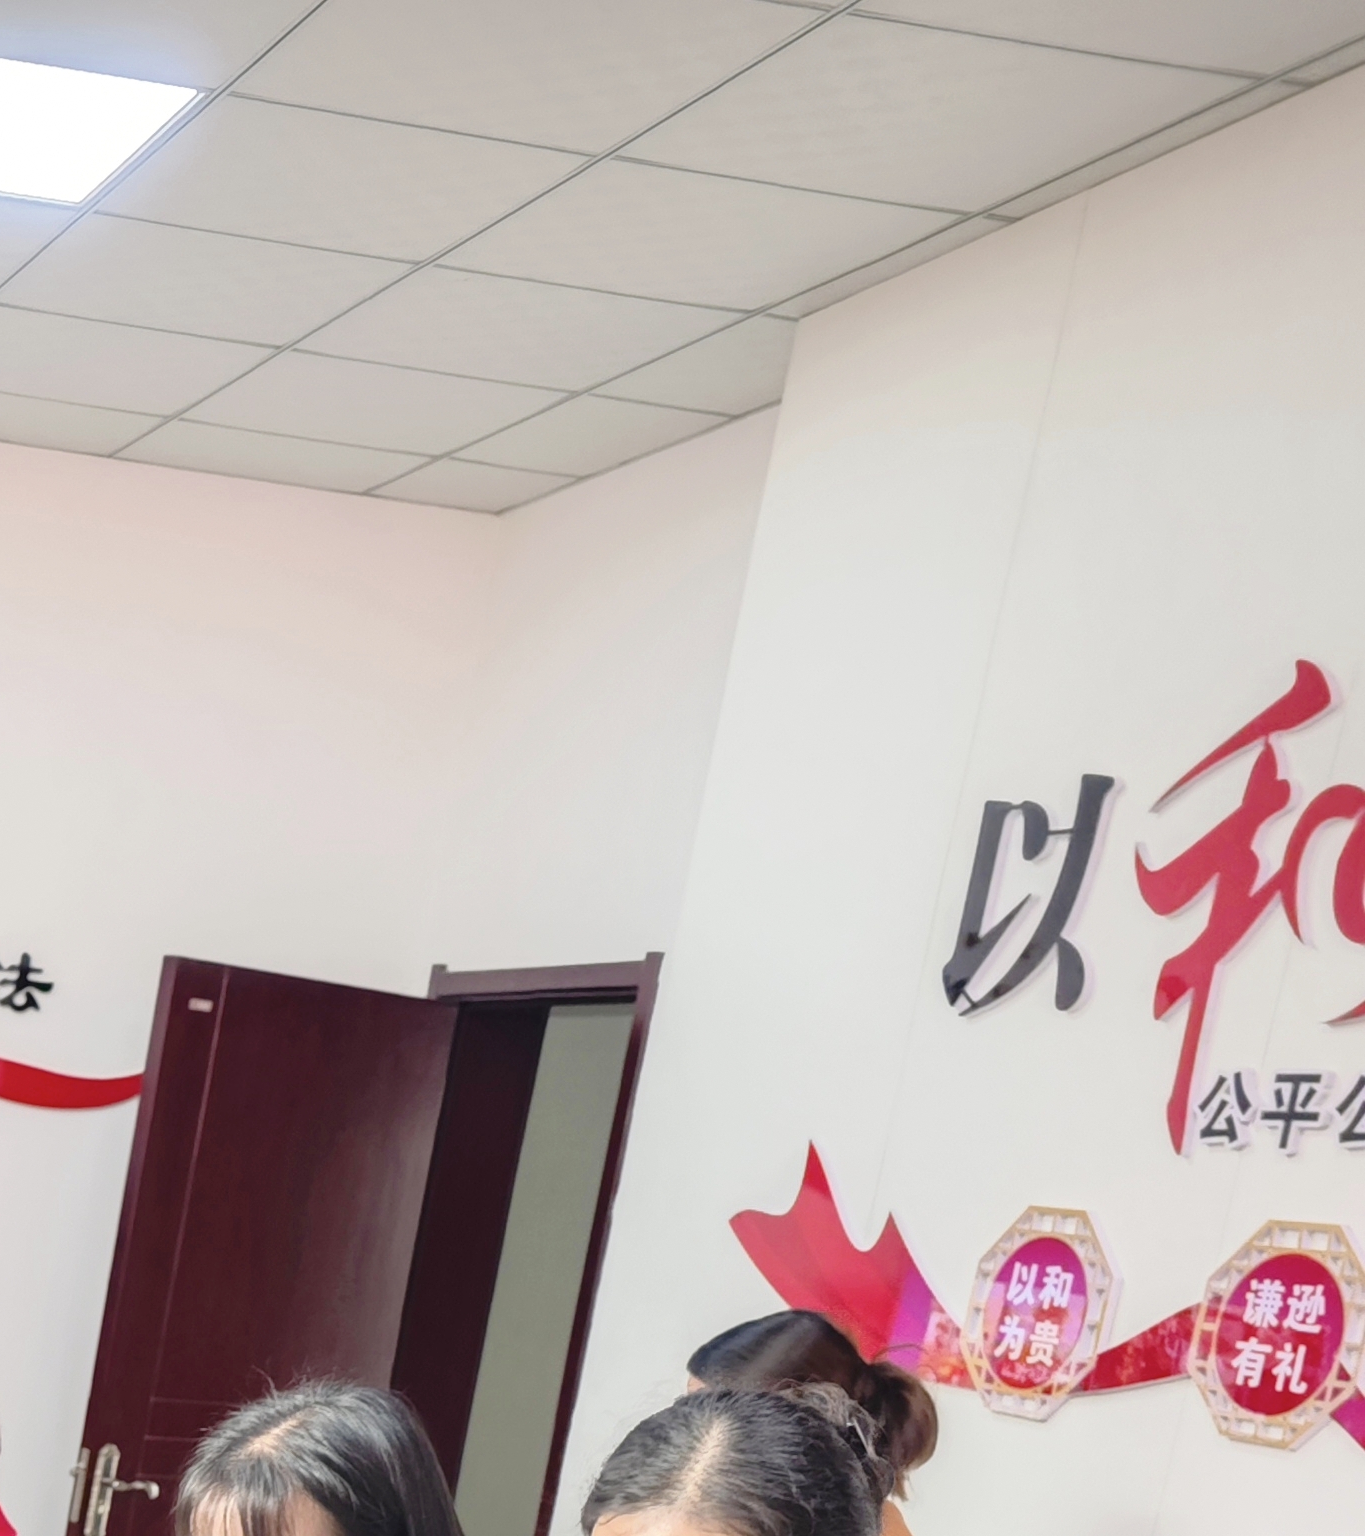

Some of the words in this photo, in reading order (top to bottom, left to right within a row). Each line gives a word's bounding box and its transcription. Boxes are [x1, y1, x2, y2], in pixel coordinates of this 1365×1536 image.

[1006, 1261, 1074, 1311] 以和
[1242, 1279, 1326, 1335] 谦逊
[994, 1316, 1061, 1368] 为贵
[1231, 1337, 1309, 1395] 有礼
